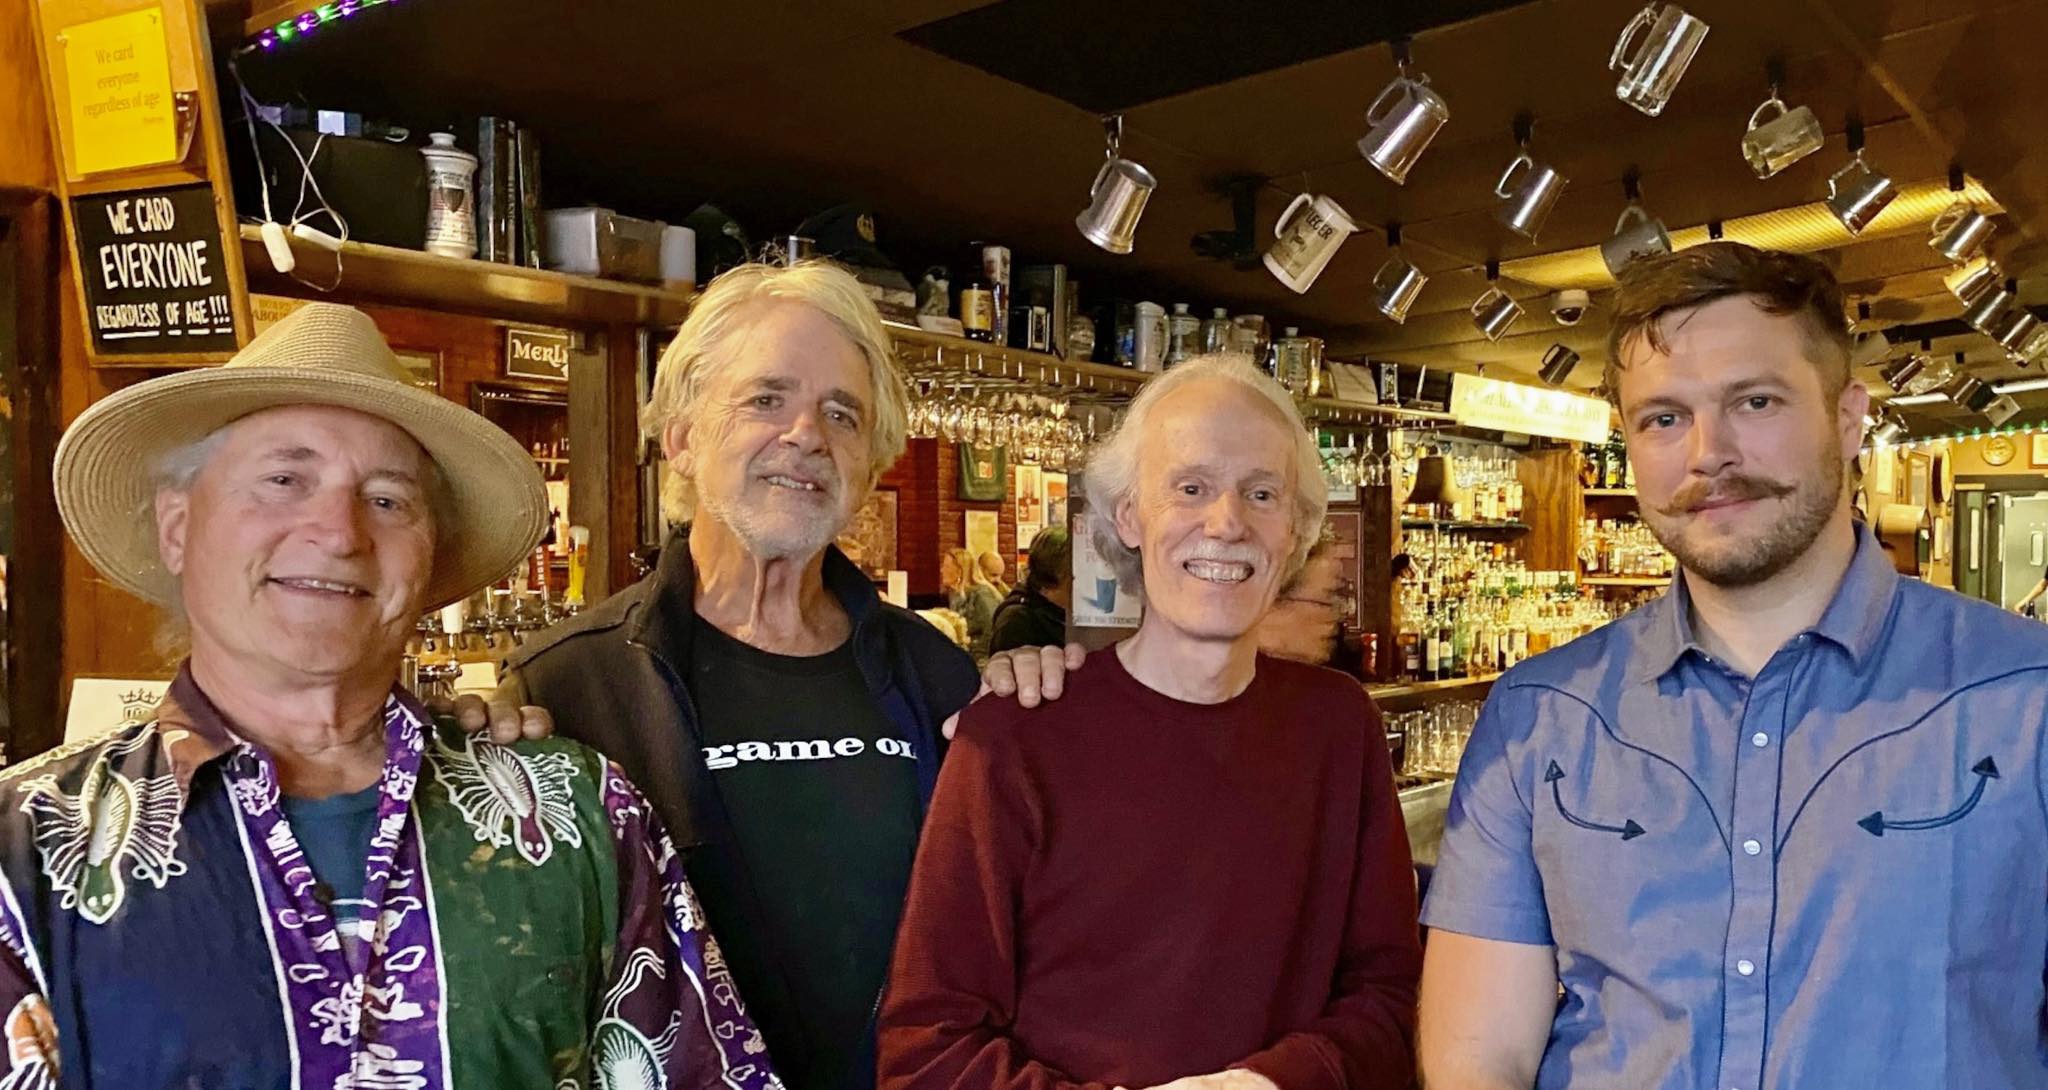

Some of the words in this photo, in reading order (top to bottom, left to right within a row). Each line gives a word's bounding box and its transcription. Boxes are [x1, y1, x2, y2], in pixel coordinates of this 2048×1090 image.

[95, 48, 112, 65] We
[113, 42, 134, 61] card
[97, 72, 140, 90] everyone
[106, 200, 134, 235] WE
[135, 197, 174, 232] CARD
[100, 240, 212, 289] EVERYONE
[96, 302, 160, 330] REGARDLESS
[165, 302, 180, 325] OF
[702, 737, 865, 770] game
